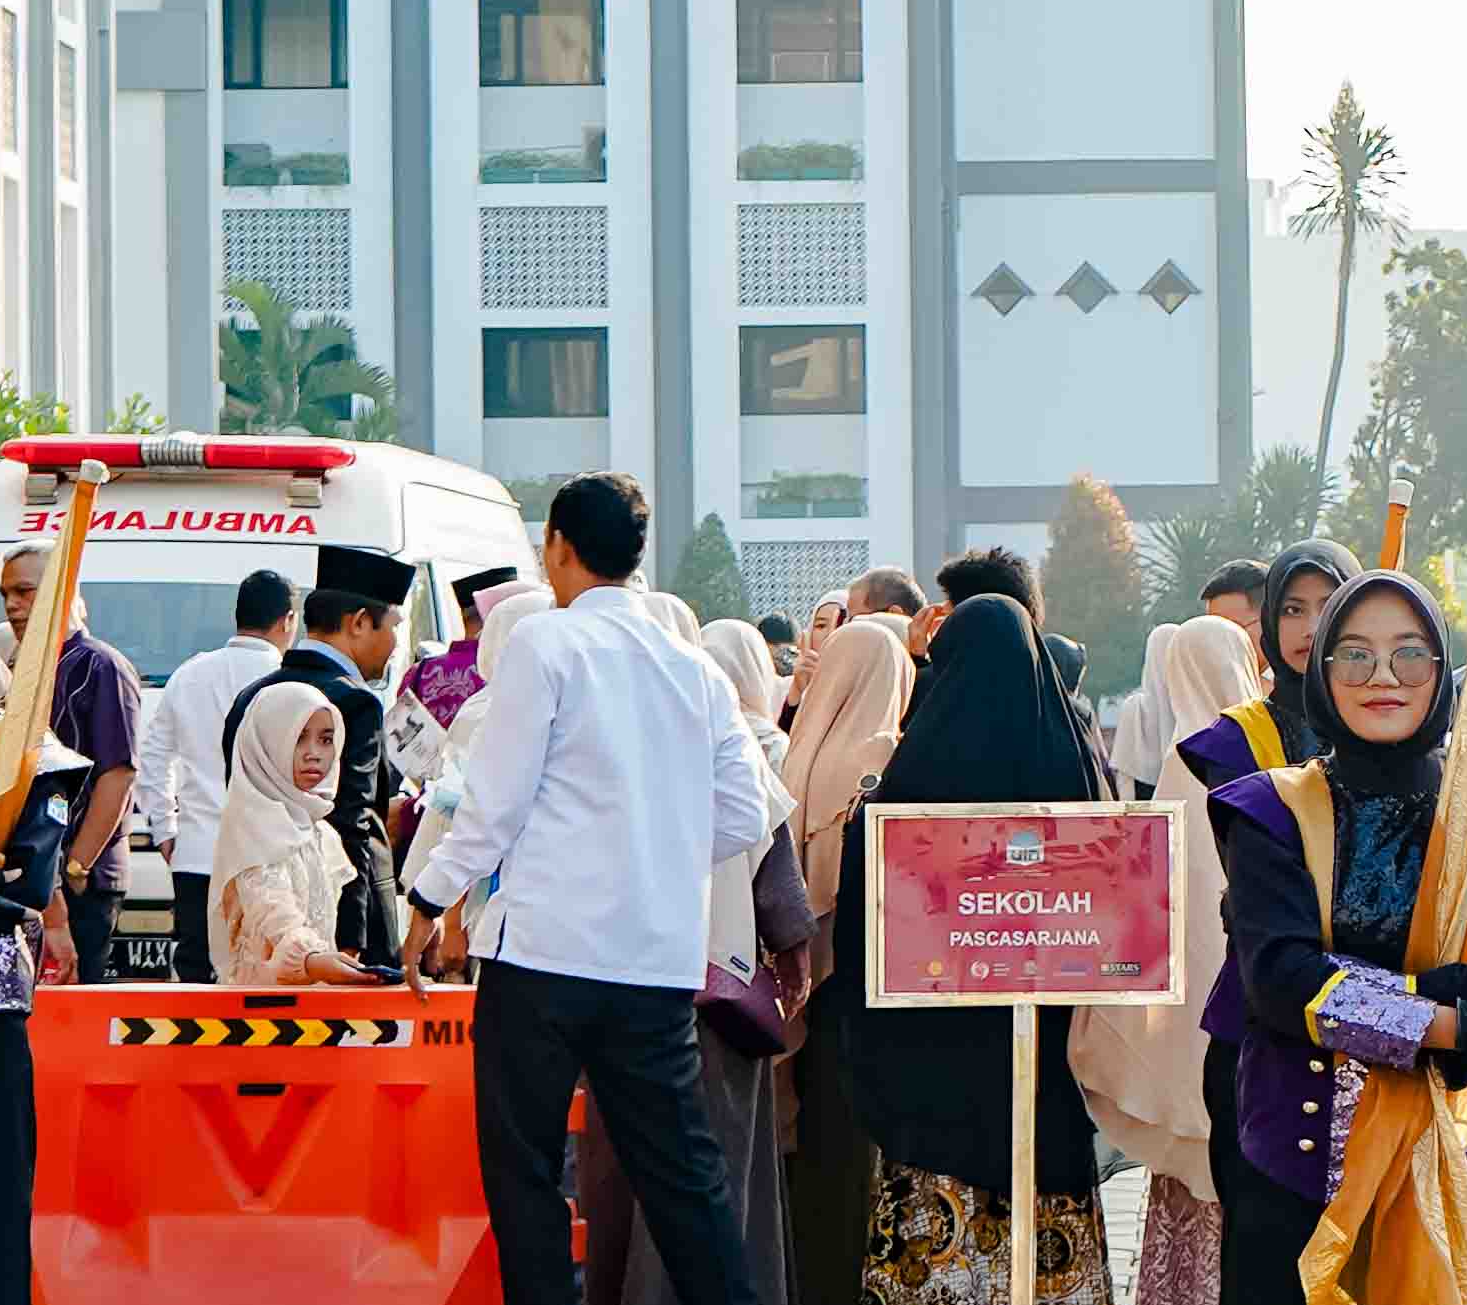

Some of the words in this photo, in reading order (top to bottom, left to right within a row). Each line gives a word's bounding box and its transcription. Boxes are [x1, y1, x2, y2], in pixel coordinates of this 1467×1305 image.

[958, 891, 1092, 915] SEKOLAH
[949, 929, 1101, 947] PASCASARJANA
[422, 1020, 477, 1045] MI
